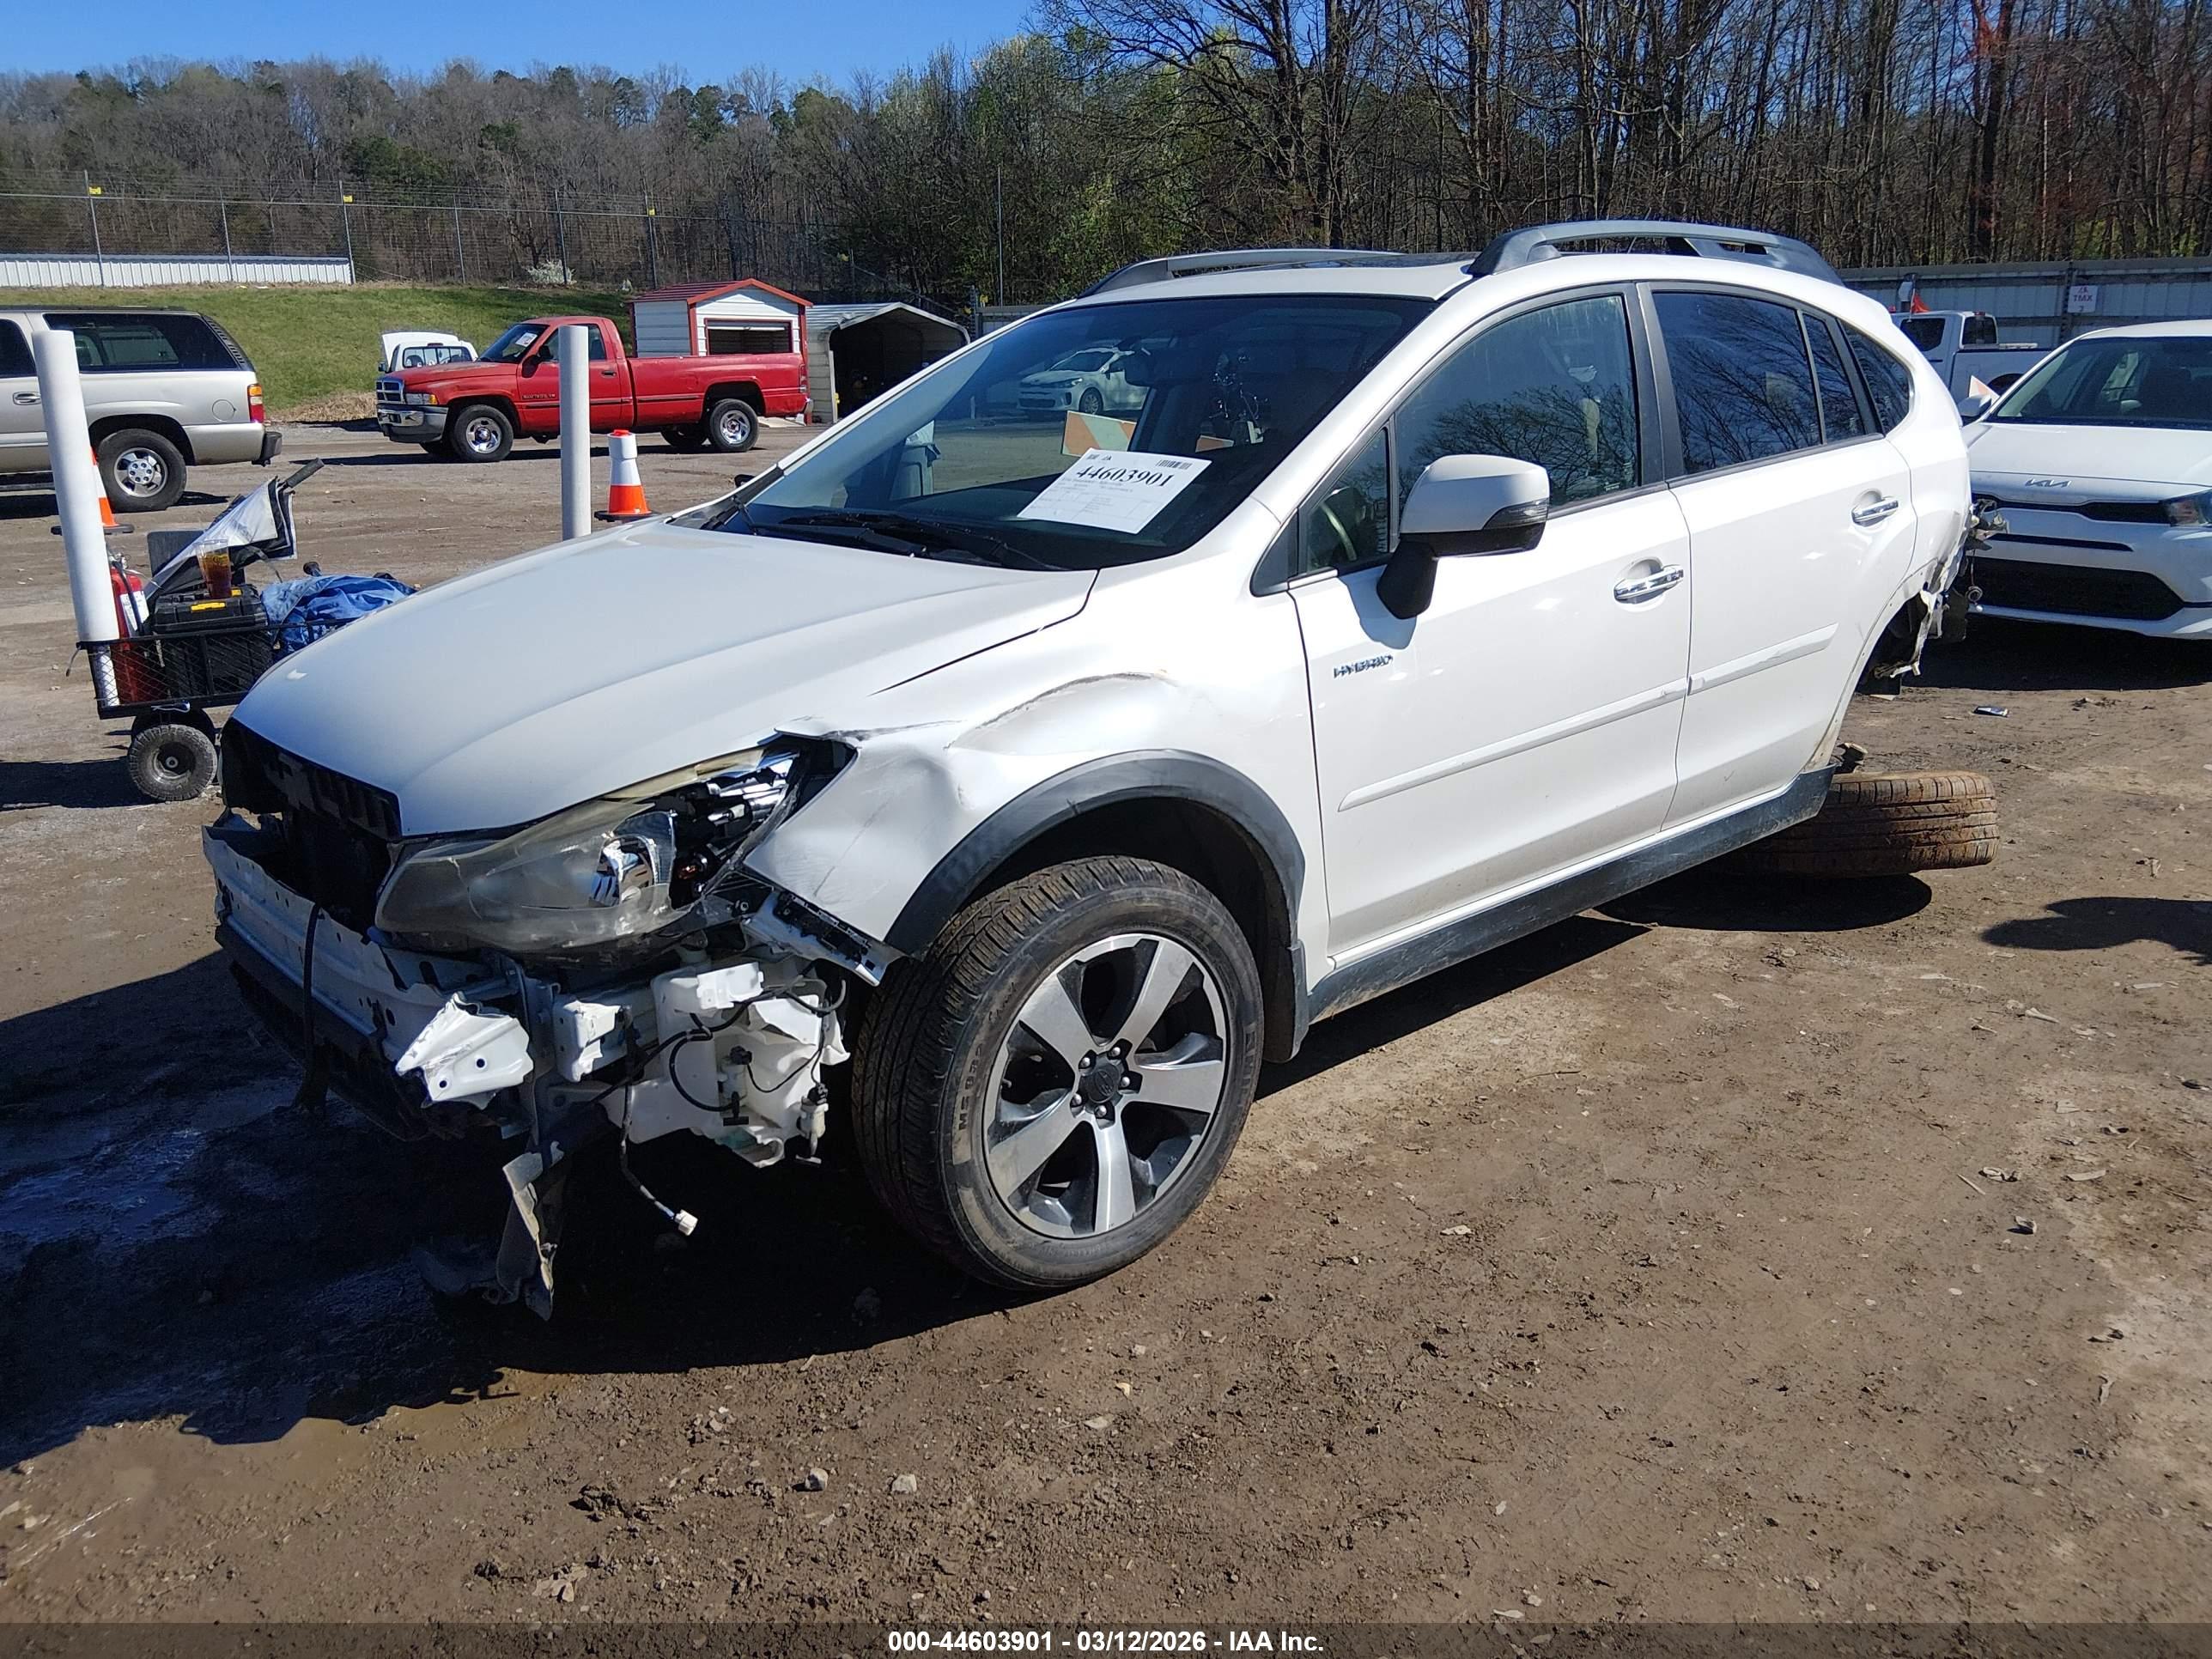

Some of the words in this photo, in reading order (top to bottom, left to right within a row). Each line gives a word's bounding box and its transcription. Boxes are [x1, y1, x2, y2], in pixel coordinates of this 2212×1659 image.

[1077, 465, 1175, 487] 44603901
[2025, 478, 2072, 488] KIA
[1334, 655, 1393, 678] HYBRID
